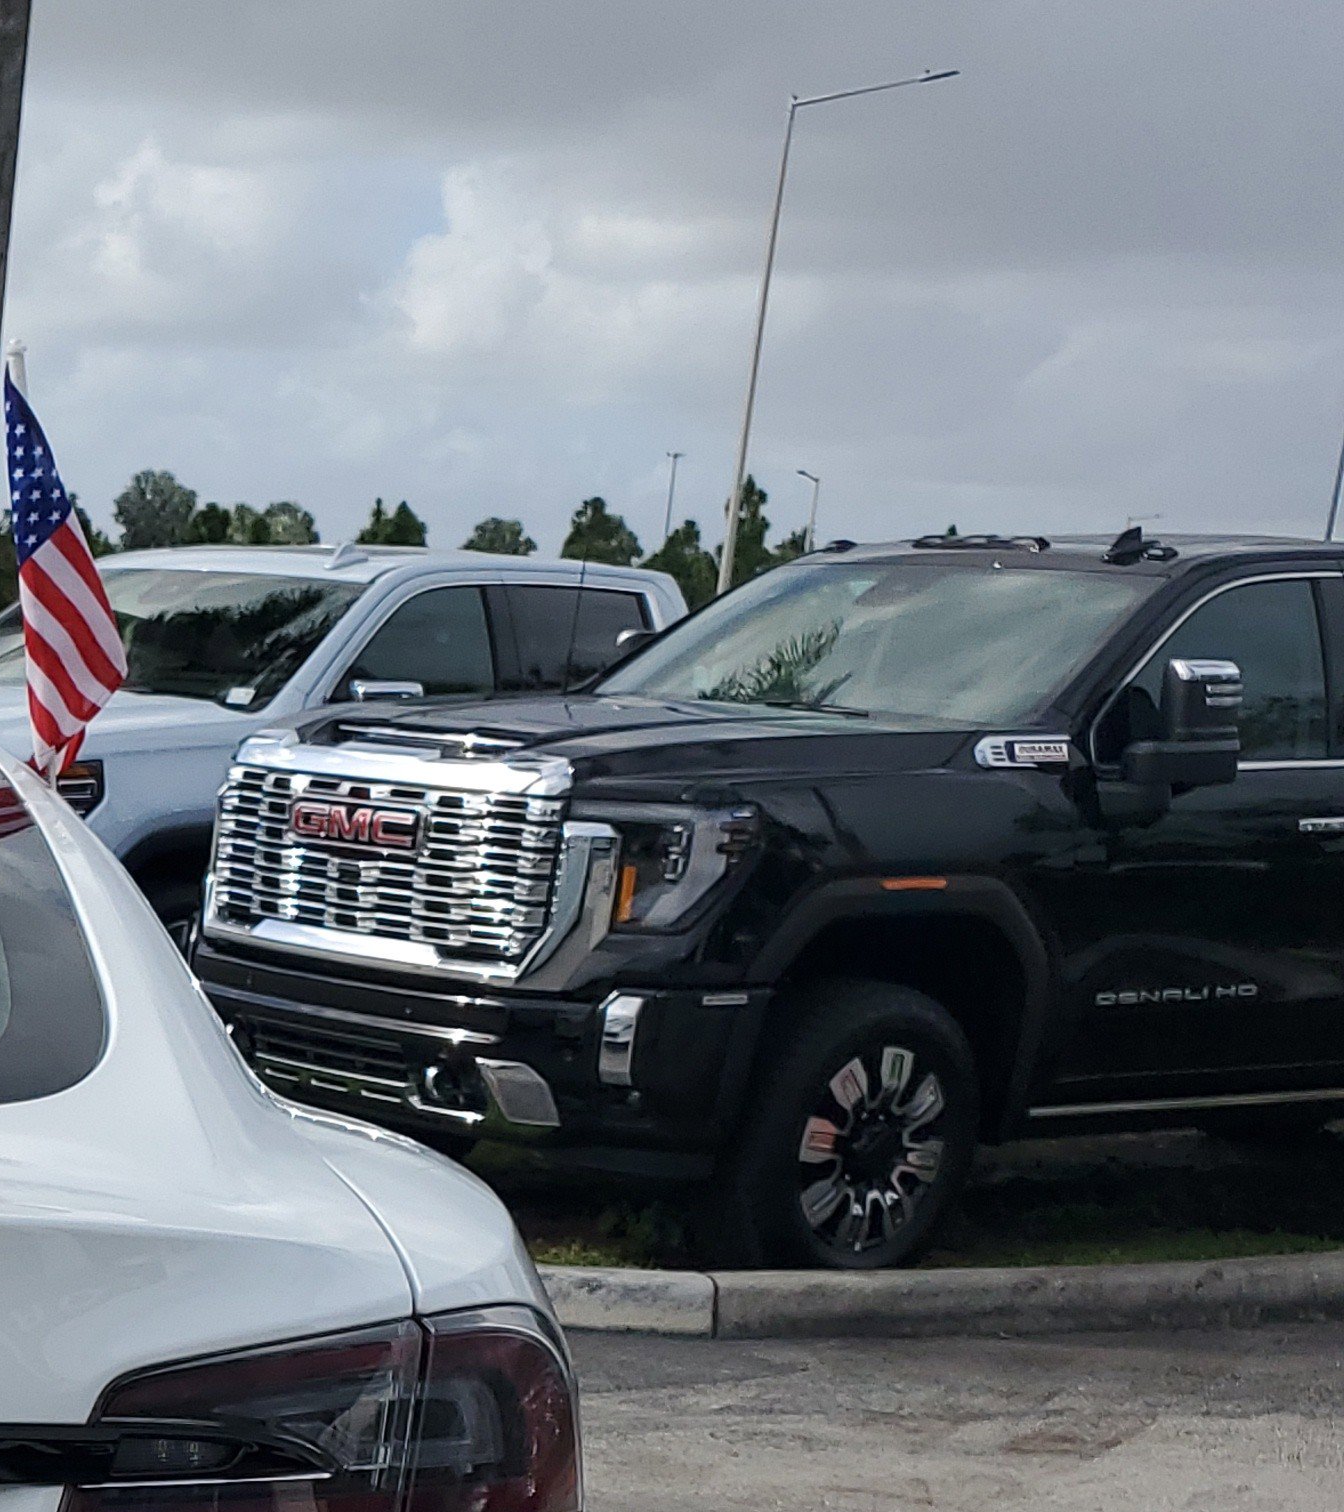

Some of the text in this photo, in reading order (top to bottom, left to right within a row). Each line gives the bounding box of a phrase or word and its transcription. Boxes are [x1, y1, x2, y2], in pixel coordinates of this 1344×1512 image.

[293, 801, 417, 848] GMC
[1096, 984, 1258, 1006] DENALI HD
